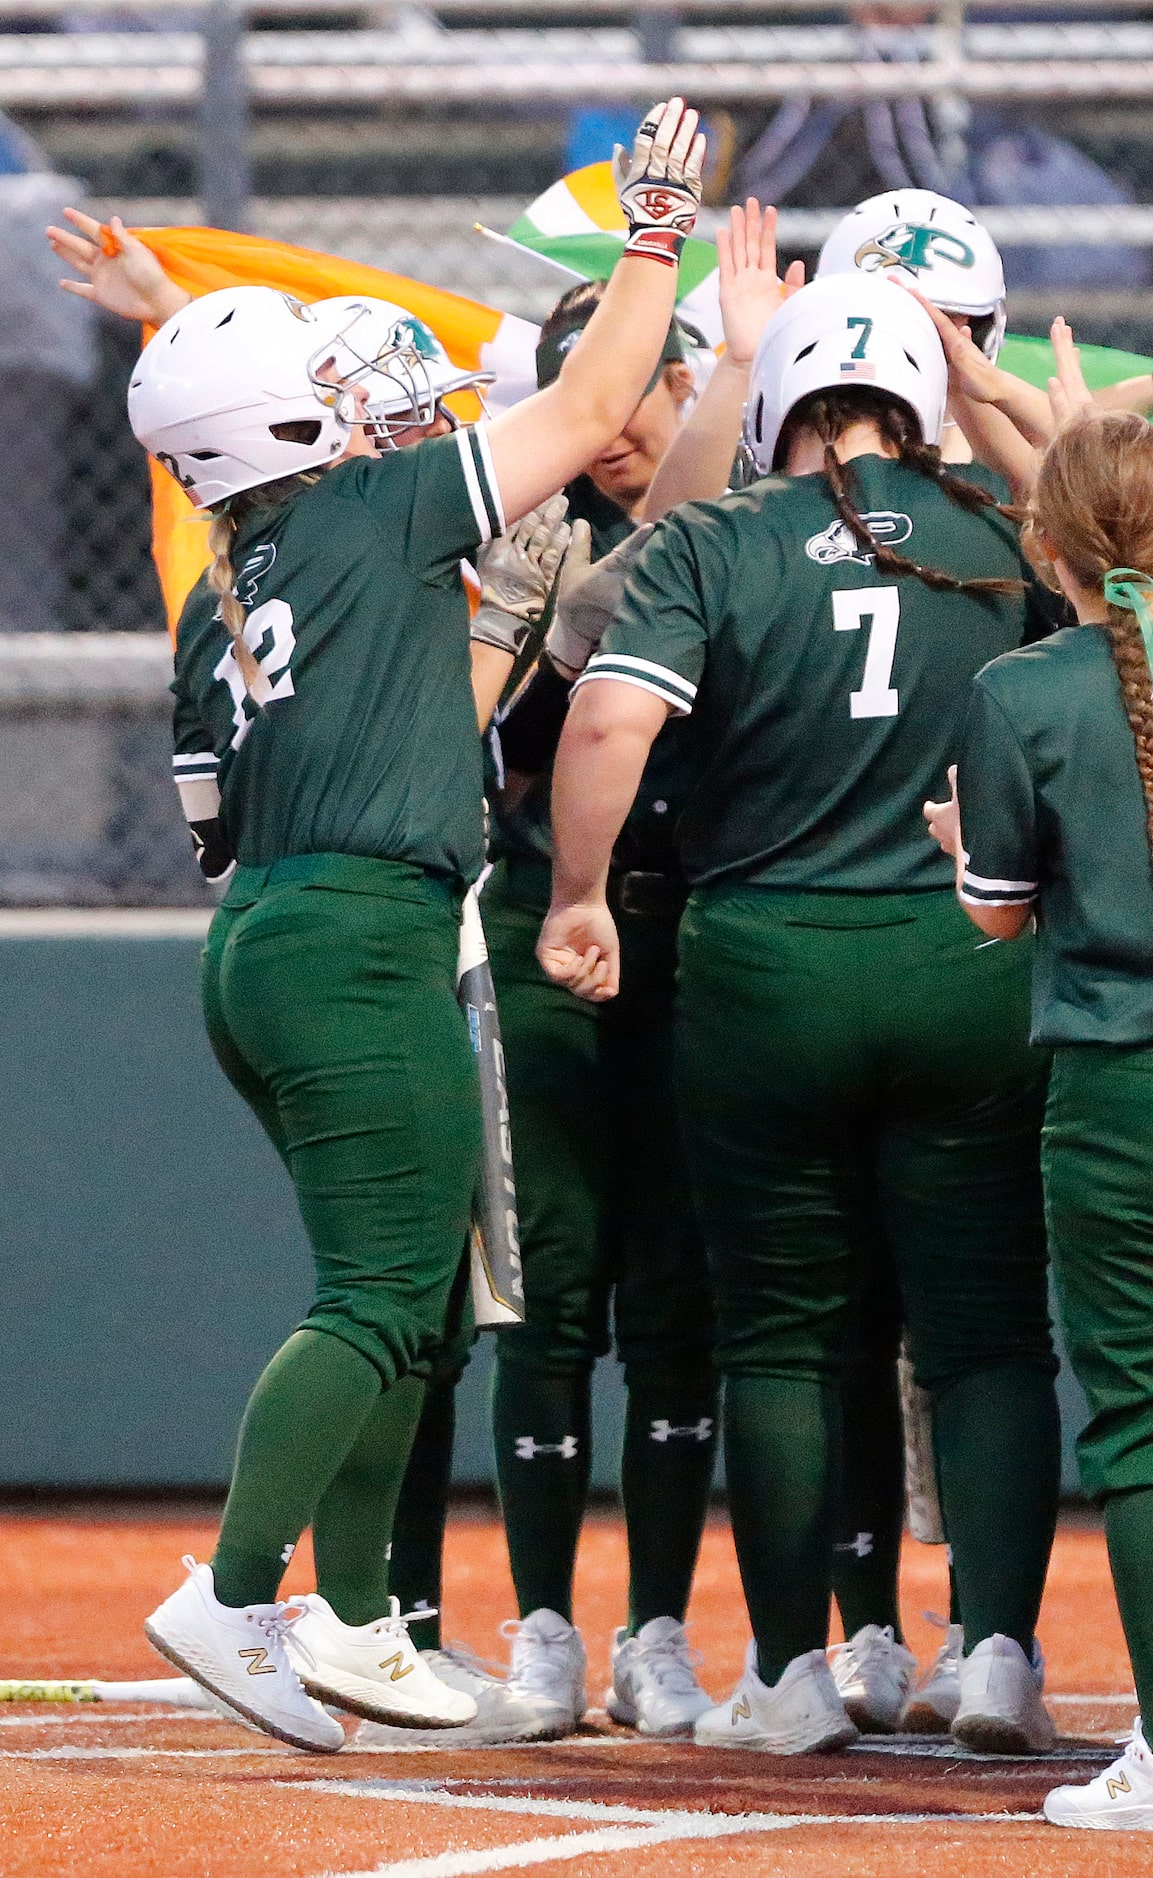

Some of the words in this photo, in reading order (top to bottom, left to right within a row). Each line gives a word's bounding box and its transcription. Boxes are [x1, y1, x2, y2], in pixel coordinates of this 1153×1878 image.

[846, 316, 874, 360] 7
[831, 585, 901, 719] 7
[237, 1647, 278, 1676] N
[378, 1650, 416, 1682] N
[1106, 1769, 1132, 1800] N
